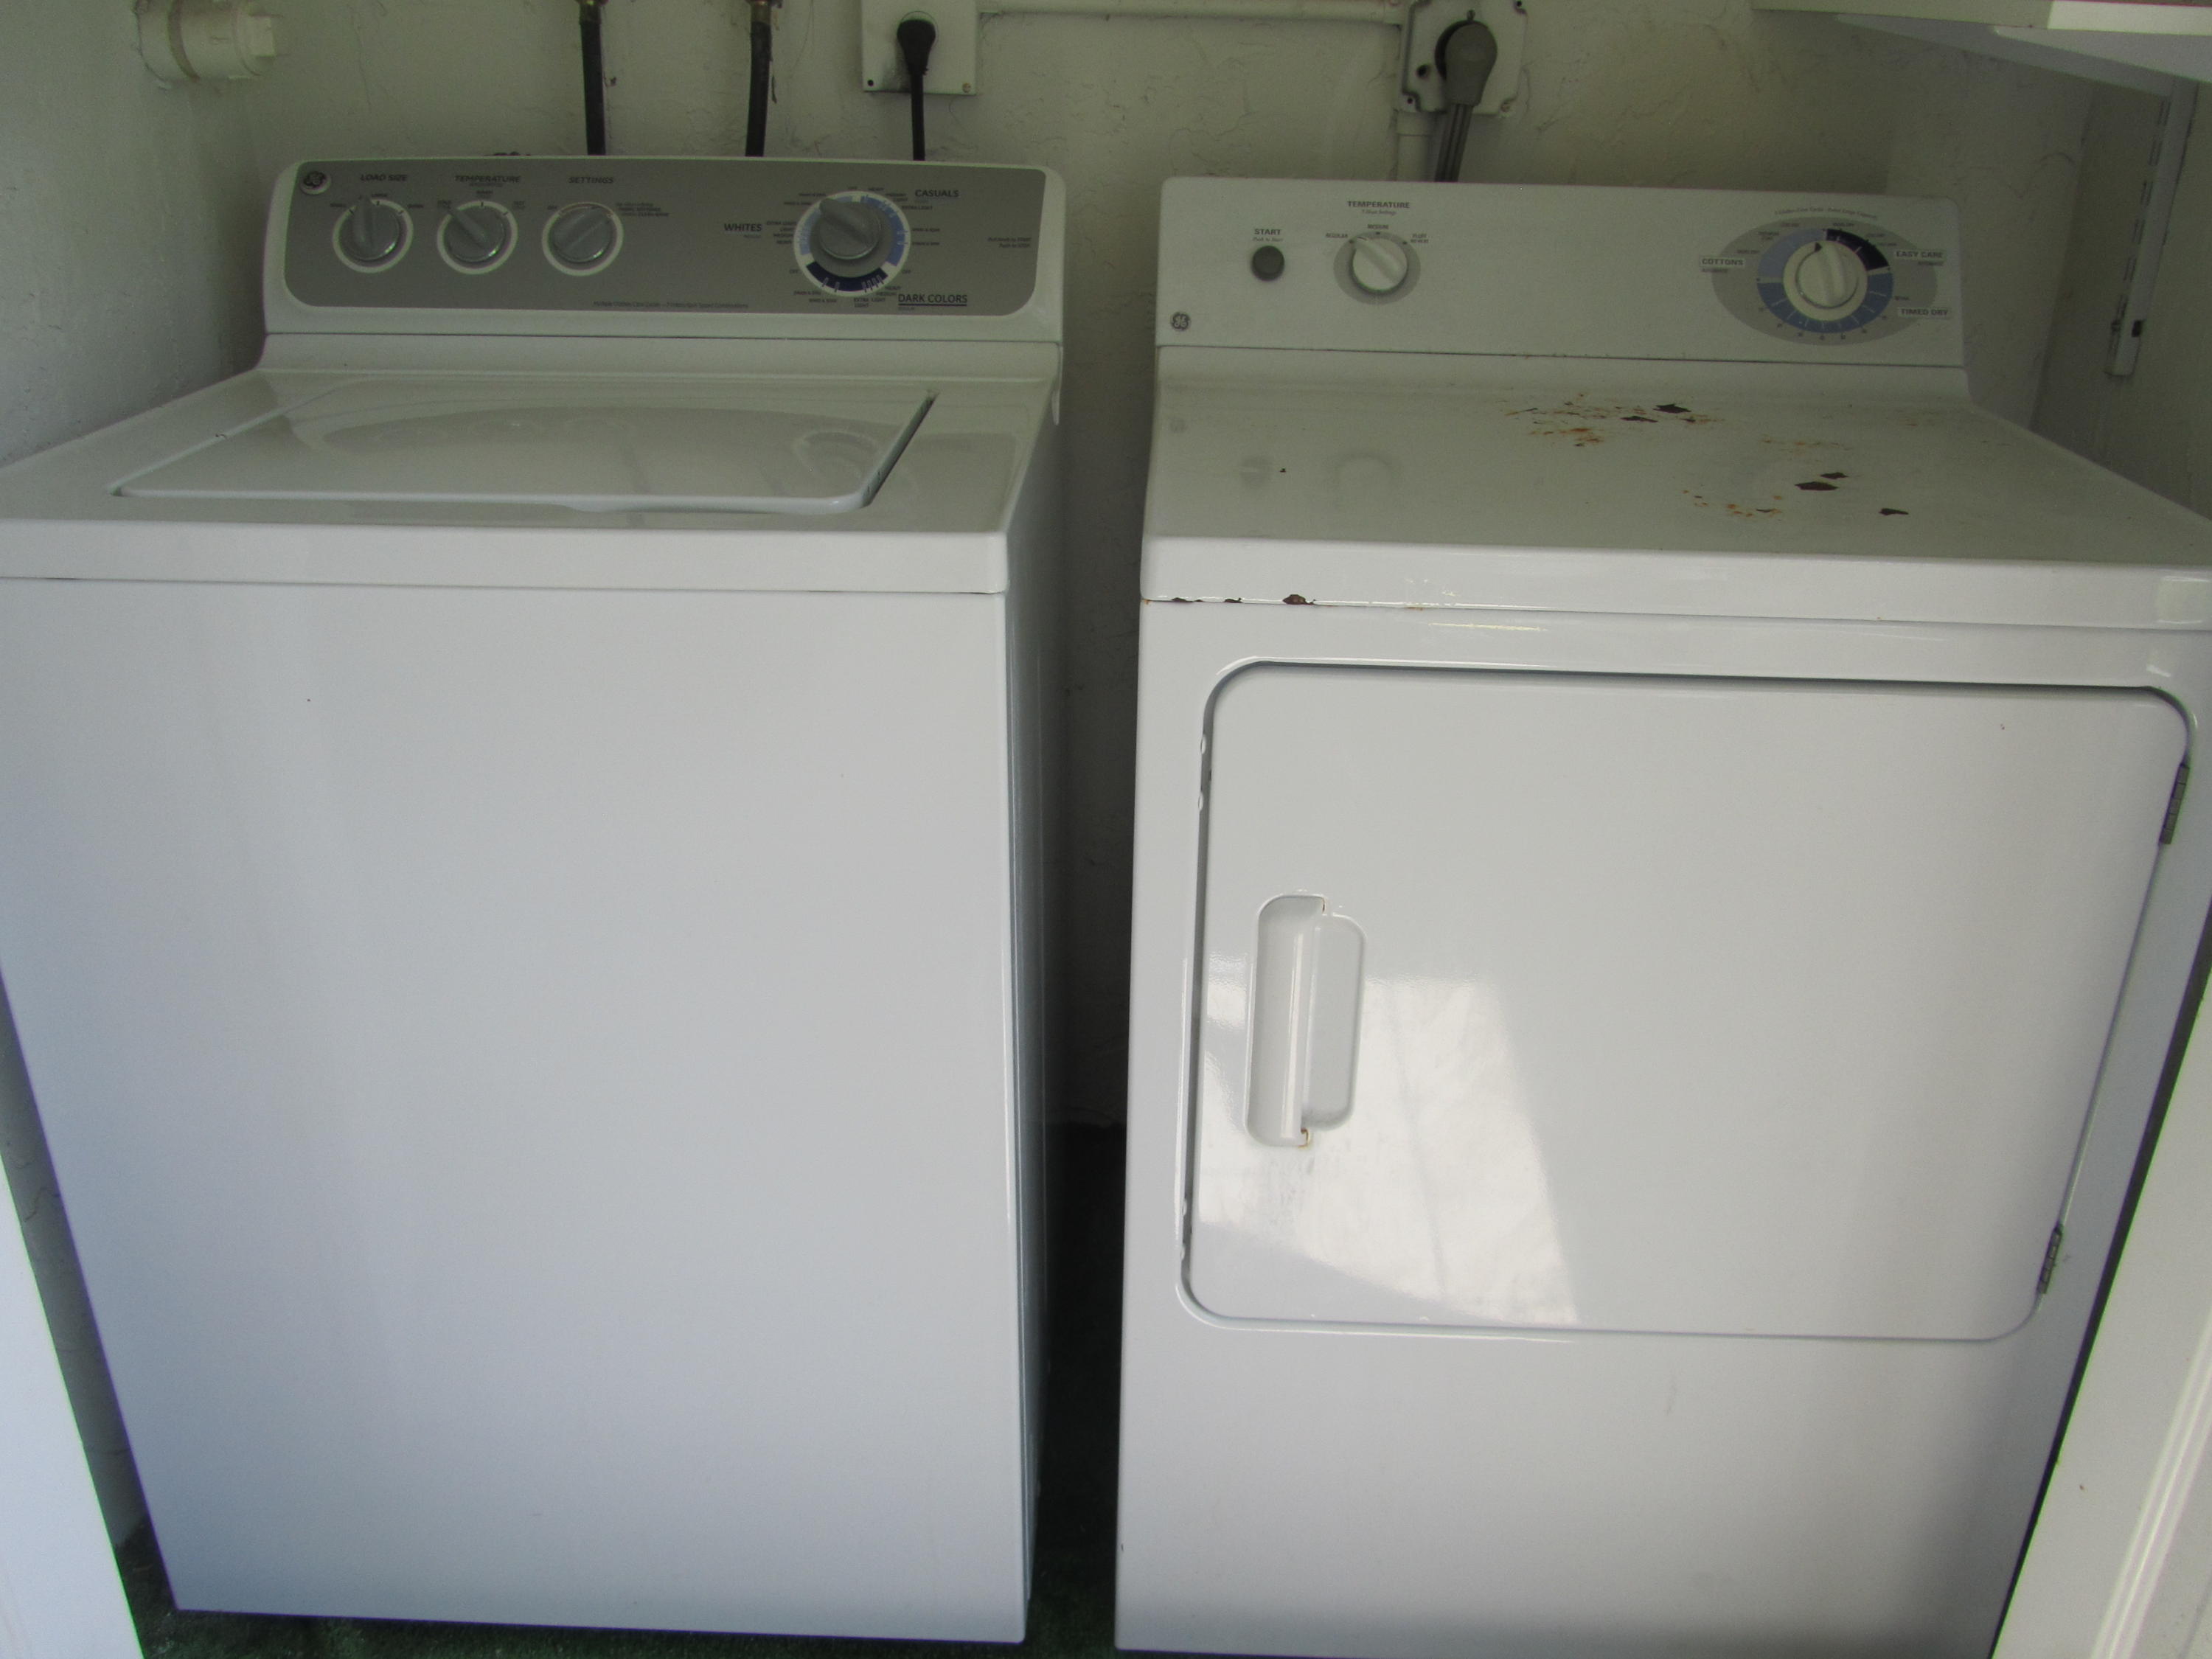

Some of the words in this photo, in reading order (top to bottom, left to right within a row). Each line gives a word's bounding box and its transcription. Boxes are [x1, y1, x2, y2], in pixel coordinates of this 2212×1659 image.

[360, 173, 386, 181] LOAD
[388, 173, 408, 181] SIZE
[455, 175, 521, 183] TEMPERATURE
[914, 189, 959, 198] CASUALS
[1347, 201, 1410, 209] TEMPERATURE
[723, 223, 762, 232] WHITES
[897, 294, 926, 304] DARK
[928, 295, 968, 305] COLORS
[1930, 308, 1949, 316] DRY
[1170, 312, 1191, 332] GE
